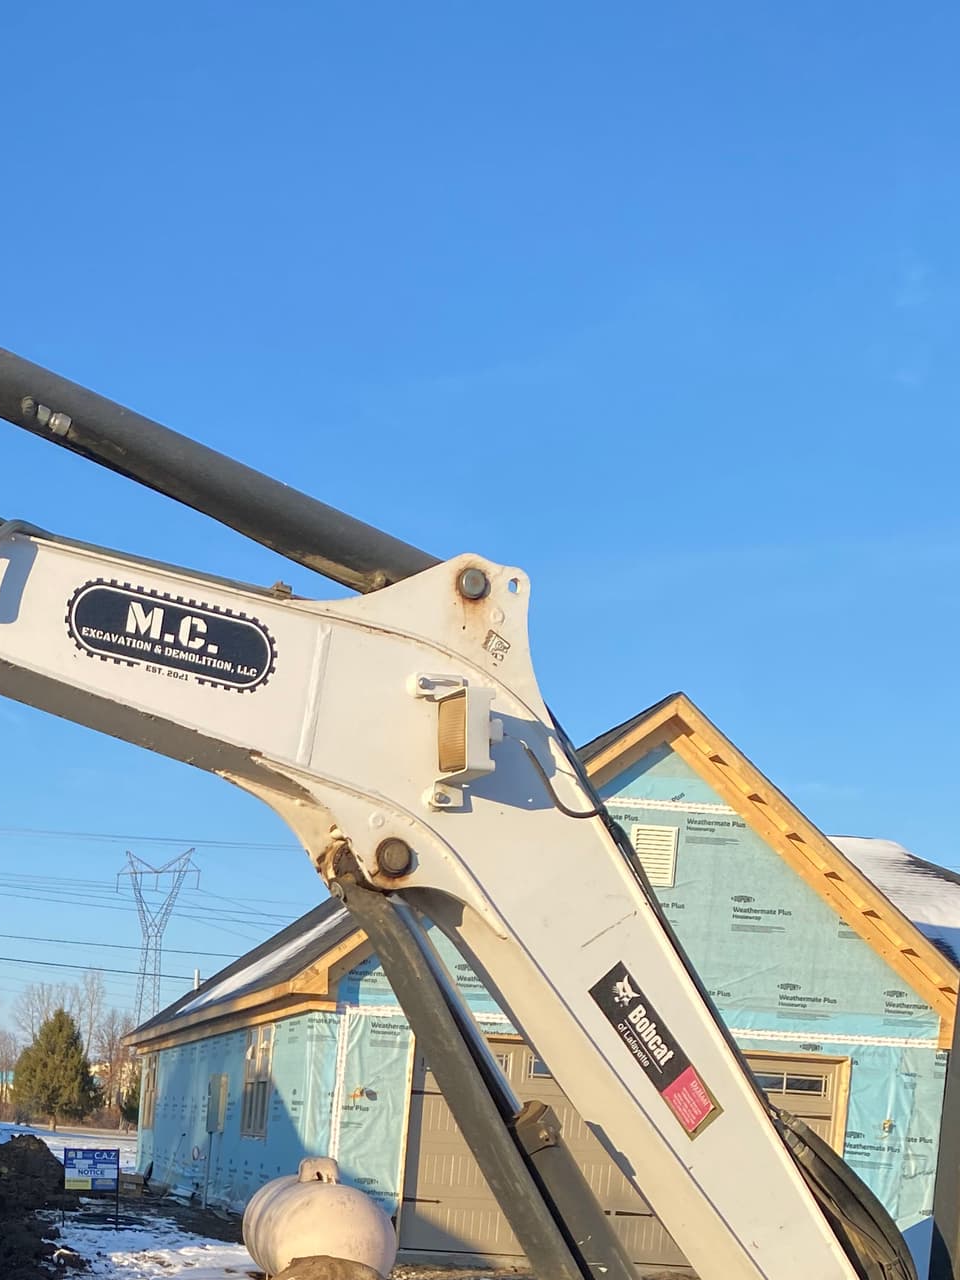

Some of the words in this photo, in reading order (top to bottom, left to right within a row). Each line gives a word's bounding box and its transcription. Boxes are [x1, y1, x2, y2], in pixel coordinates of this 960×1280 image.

[125, 601, 219, 655] M.C.
[81, 626, 152, 652] EXCAVATION
[154, 643, 162, 654] &
[164, 647, 235, 674] DEMOLITION,
[237, 664, 258, 678] LLC
[145, 664, 165, 676] EST.
[167, 669, 189, 681] 2021
[624, 814, 639, 822] Plus
[686, 818, 731, 828] Weathermate
[732, 821, 747, 829] Plus
[732, 906, 777, 916] Weathermate
[777, 908, 792, 916] Plus
[717, 990, 731, 998] Plus
[778, 994, 822, 1003] Weathermate
[885, 1001, 929, 1010] Weathermate
[628, 1004, 675, 1066] Bobcat
[617, 1023, 627, 1034] of
[623, 1030, 650, 1068] Lafayette
[887, 1145, 900, 1153] Plus
